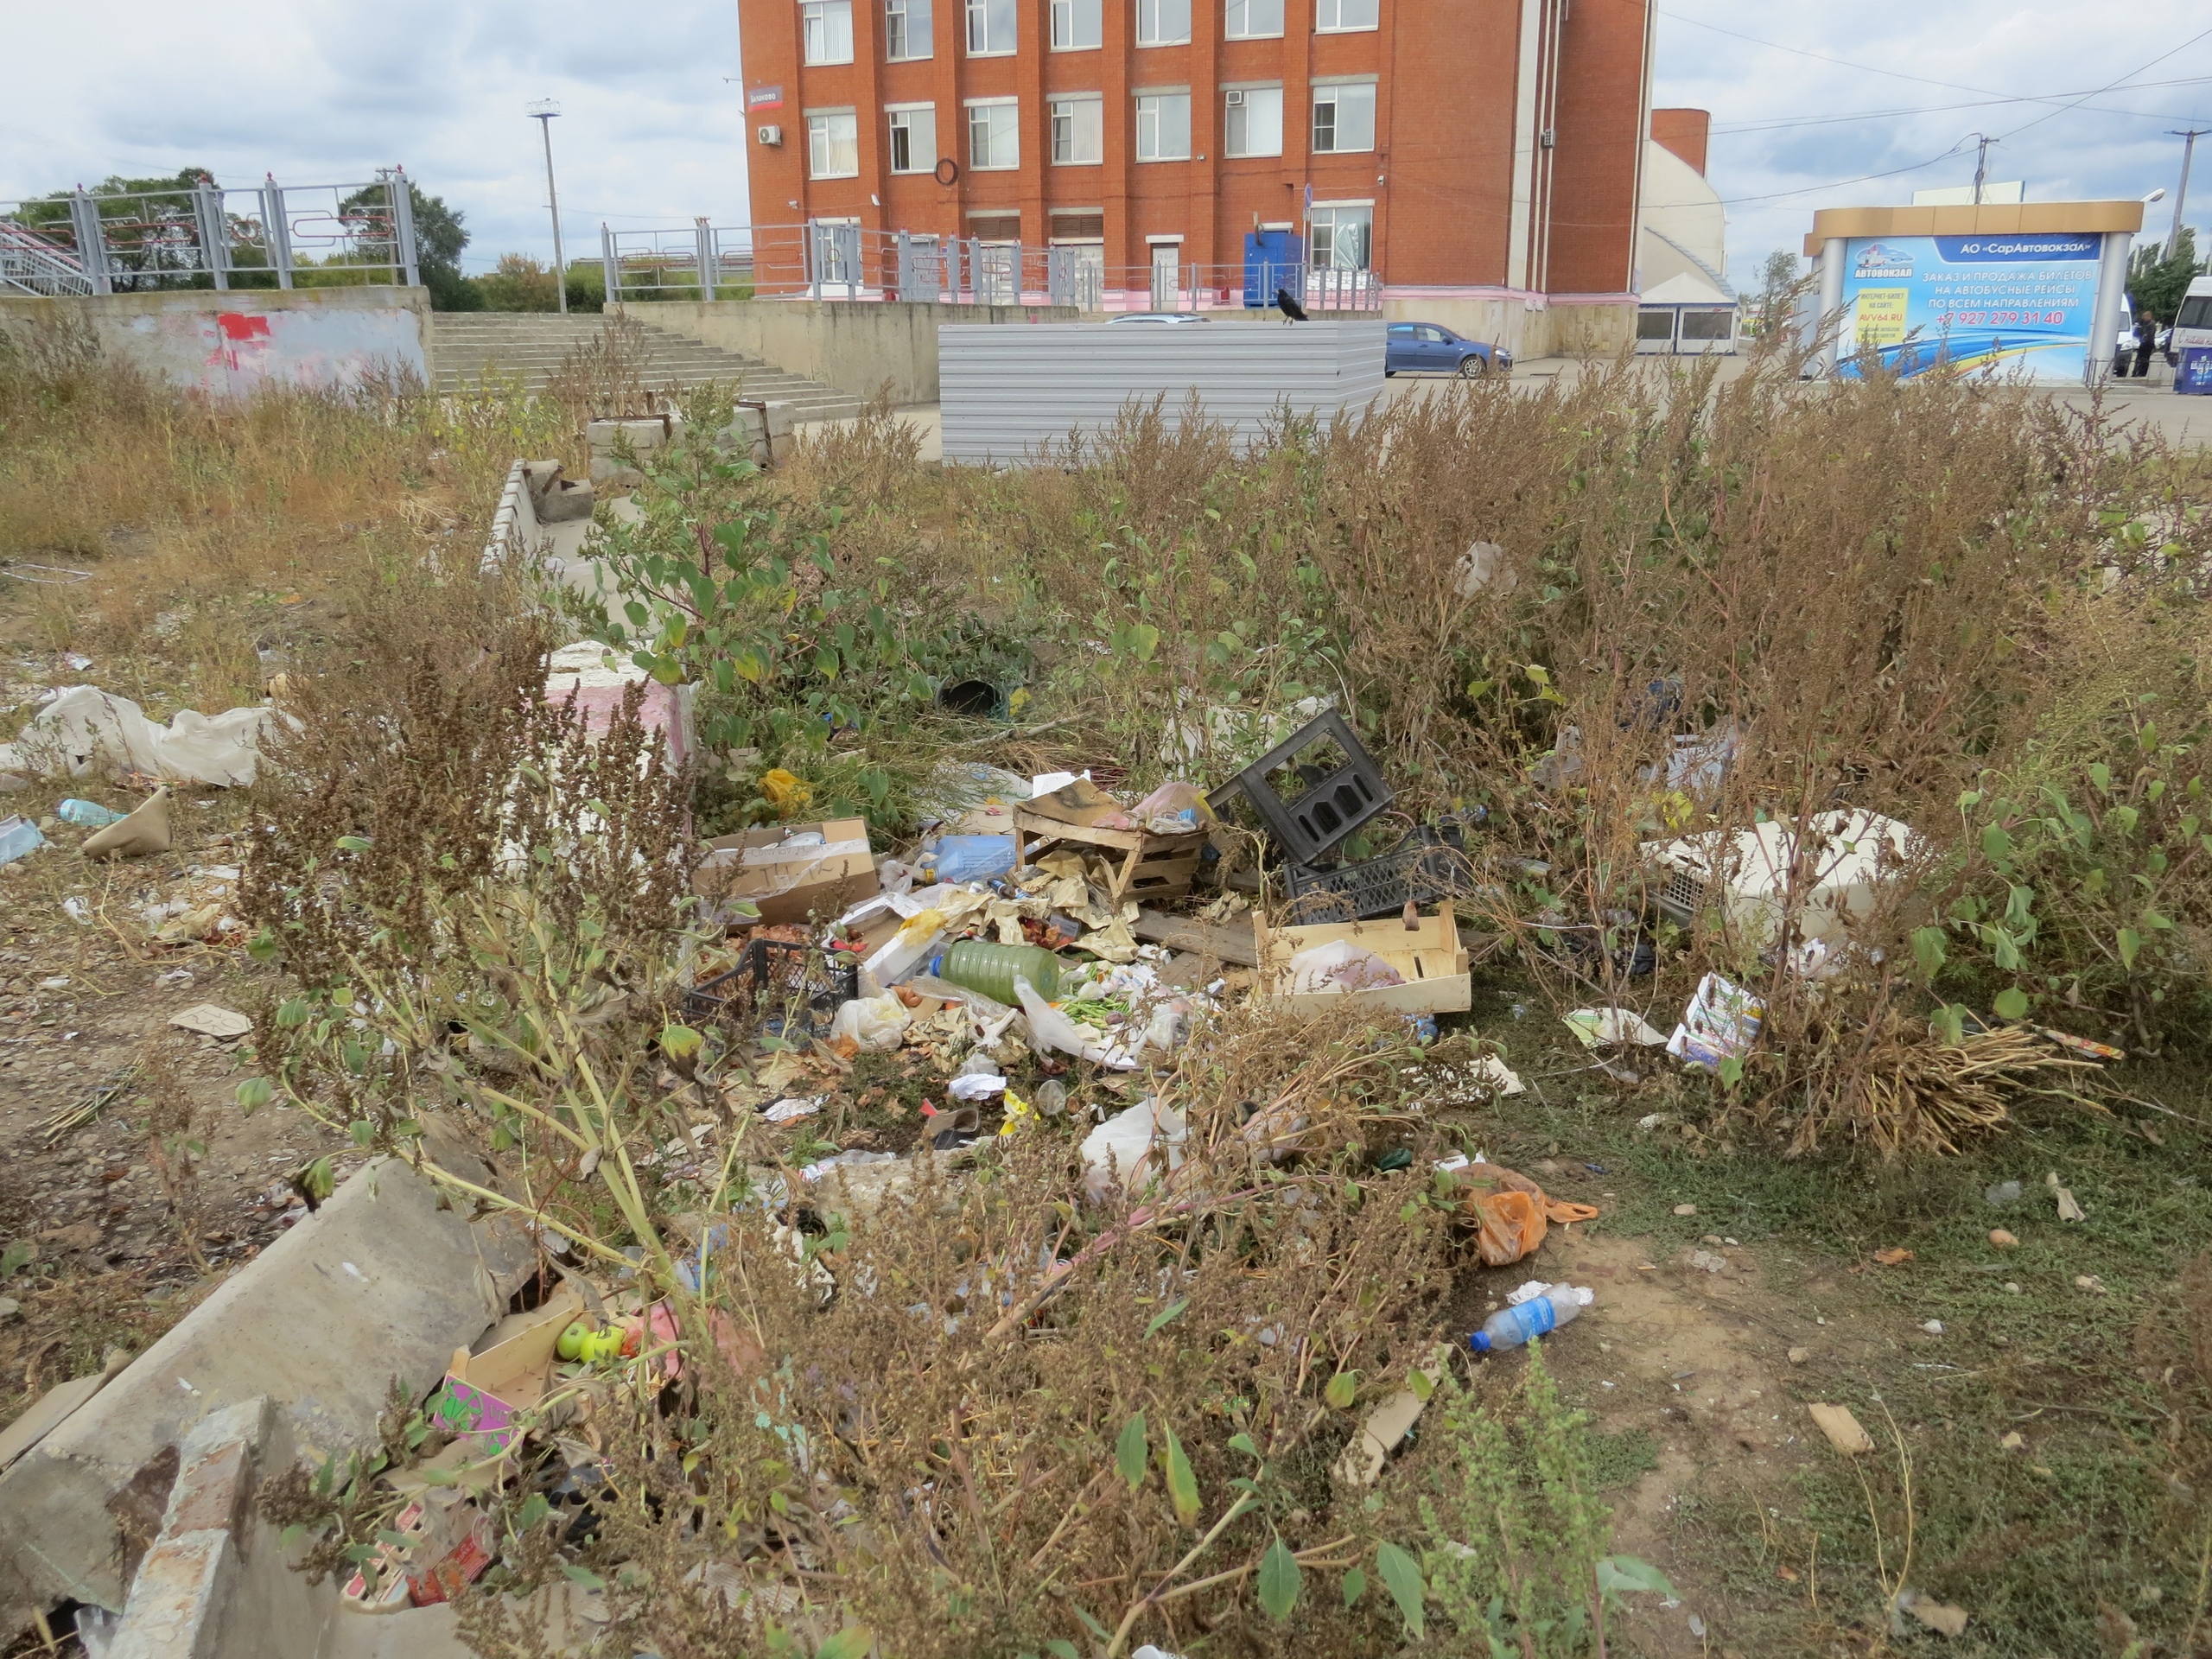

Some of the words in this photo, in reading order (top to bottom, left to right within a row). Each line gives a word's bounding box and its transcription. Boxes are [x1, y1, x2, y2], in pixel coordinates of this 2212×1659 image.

[1960, 244, 1980, 254] АО
[1982, 243, 2091, 255] «СарАвтовокзал»
[1854, 268, 1912, 278] АВТОВОКЗАЛ
[1922, 272, 1960, 283] ЗАКАЗ
[1961, 272, 1971, 282] И
[1973, 271, 2036, 283] ПРОДАЖА
[2038, 270, 2093, 281] БИЛЕТОВ
[1935, 286, 1951, 295] НА
[1954, 284, 2031, 295] АВТОБУСНЫЕ
[2033, 283, 2075, 295] РЕЙСЫ
[1928, 299, 1946, 308] ПО
[1948, 299, 1980, 308] ВСЕМ
[1983, 298, 2080, 308] НАПРАВЛЕНИЯМ
[1959, 312, 1986, 325] 927
[1990, 312, 2018, 325] 279
[2020, 311, 2040, 325] 31
[2043, 311, 2063, 325] 40
